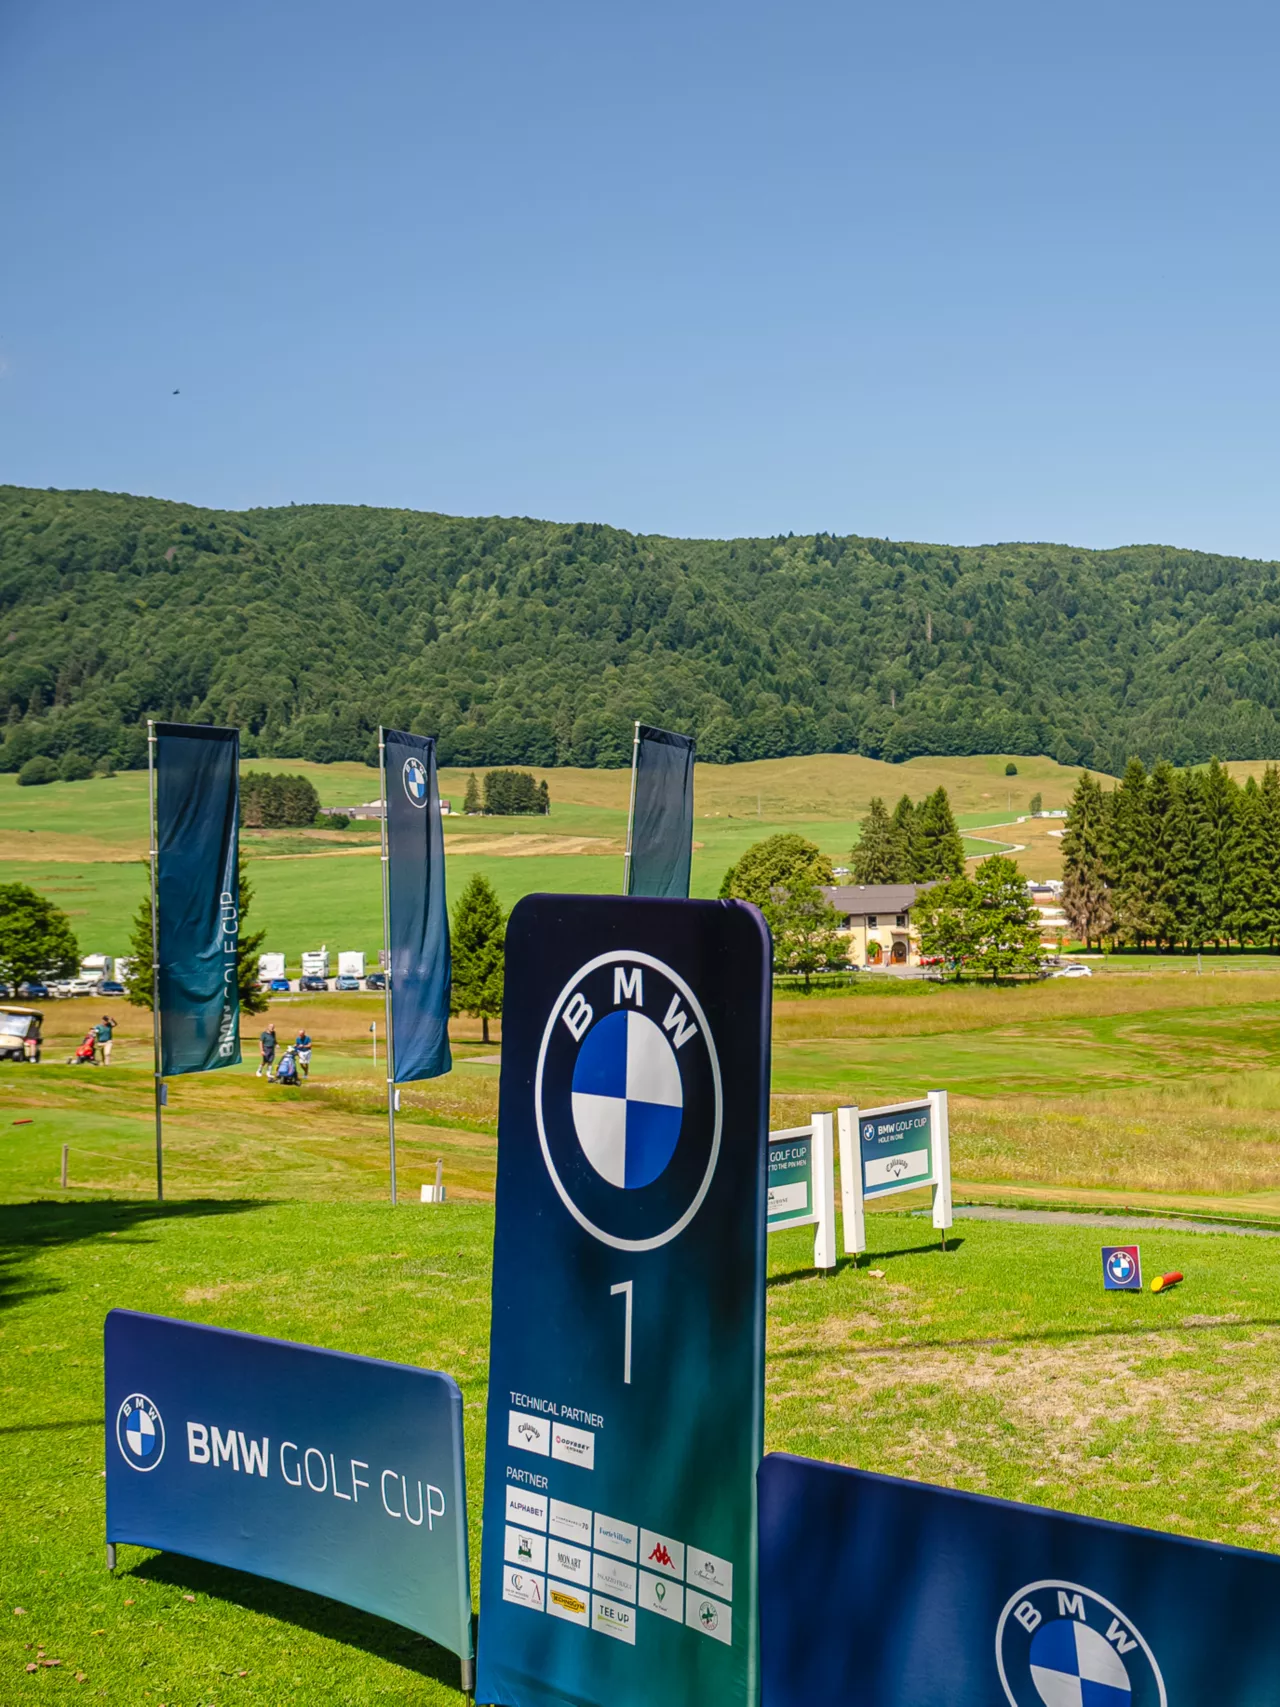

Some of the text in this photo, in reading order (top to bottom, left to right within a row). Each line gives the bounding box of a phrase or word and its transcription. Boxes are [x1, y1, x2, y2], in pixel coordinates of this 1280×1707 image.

[219, 891, 239, 935] CUP
[562, 966, 698, 1050] BMW
[877, 1124, 895, 1135] BMW
[896, 1120, 913, 1132] GOLF
[914, 1117, 927, 1128] CUP
[878, 1136, 889, 1144] HOLE
[770, 1147, 807, 1162] GOLF CUP
[778, 1162, 788, 1170] THE
[610, 1280, 633, 1384] 1
[123, 1397, 157, 1421] BMW
[510, 1391, 604, 1428] TECHNICAL PARTNER
[518, 1423, 540, 1439] Callaway
[561, 1438, 590, 1450] ODYSSEY
[187, 1421, 446, 1531] BMW GOLF CUP
[506, 1466, 548, 1489] PARTNER
[510, 1500, 544, 1517] ALPHABET
[600, 1604, 630, 1624] TEE UP
[1013, 1591, 1138, 1655] BMW
